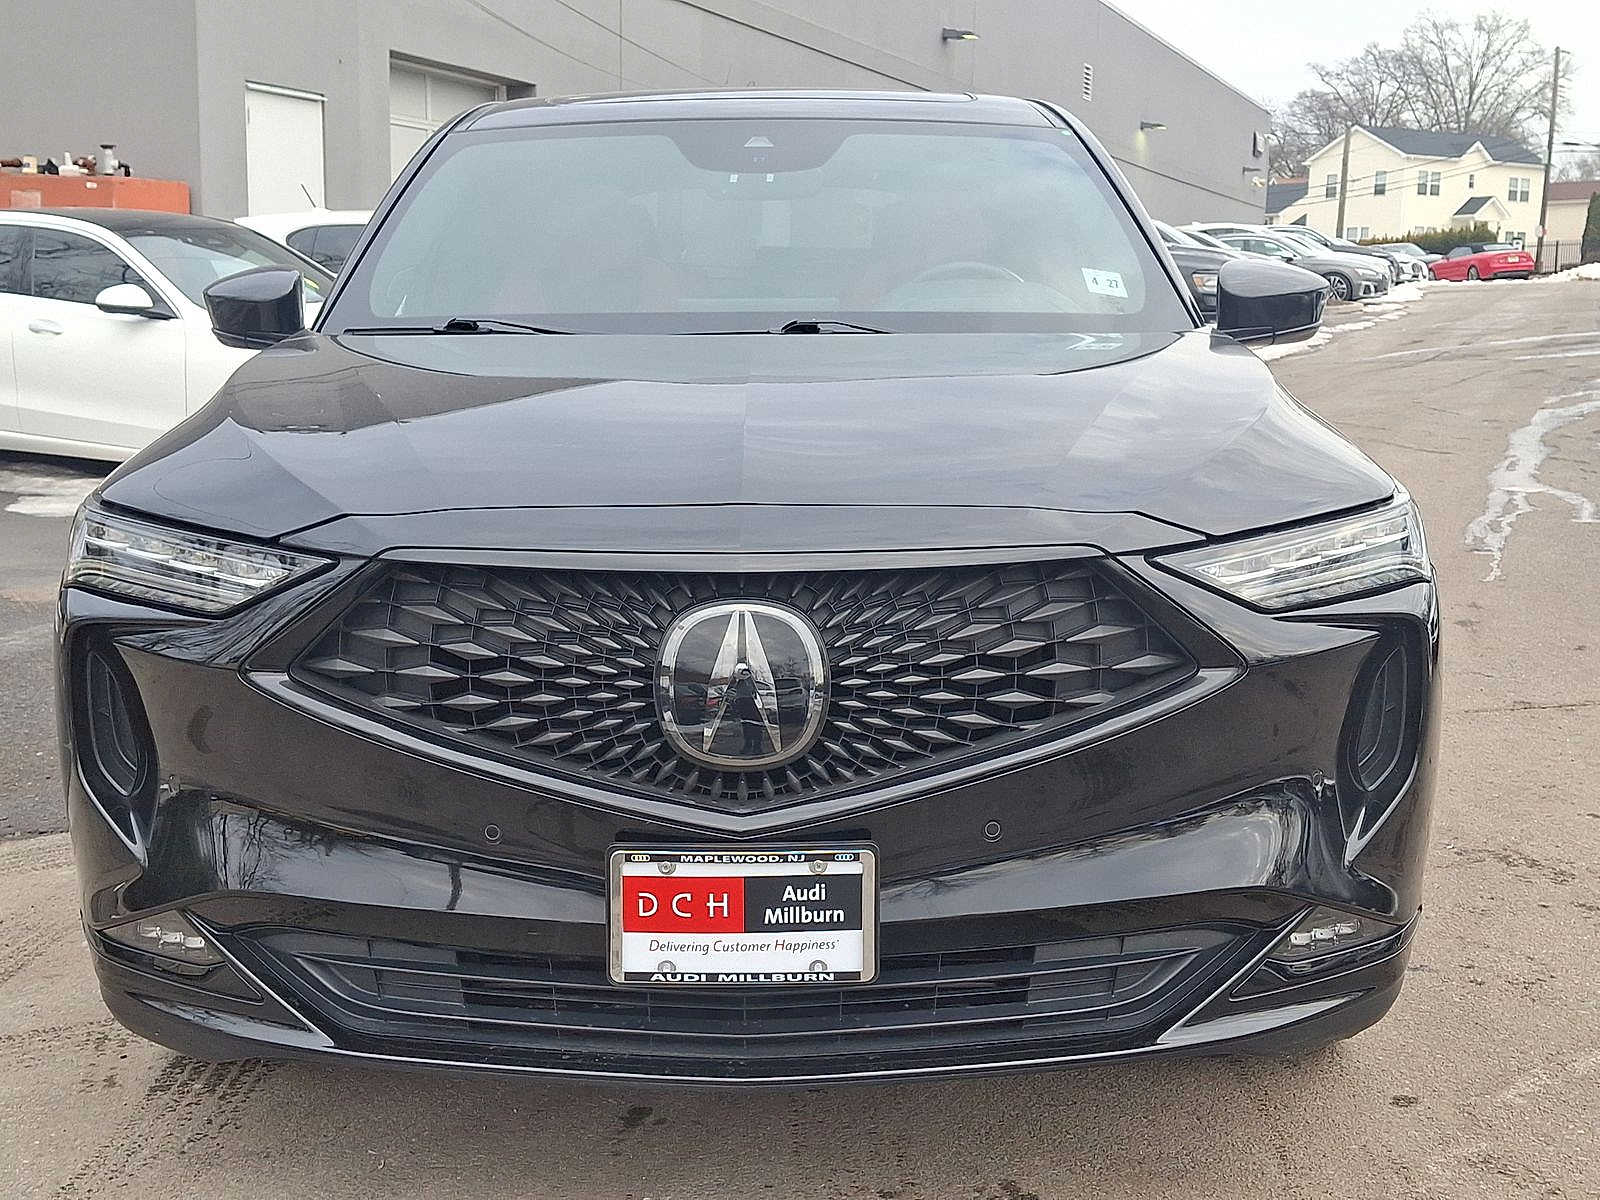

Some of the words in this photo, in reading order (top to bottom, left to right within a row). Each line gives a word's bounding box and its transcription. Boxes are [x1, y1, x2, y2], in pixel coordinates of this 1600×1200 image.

[680, 854, 785, 864] MAPLEWOOD,
[788, 854, 806, 863] NJ
[782, 883, 826, 902] Audi
[763, 906, 845, 925] Millburn
[649, 939, 710, 956] Delivering
[713, 939, 771, 953] Customer
[650, 973, 707, 982] AUDI
[717, 972, 835, 982] MILLBURN
